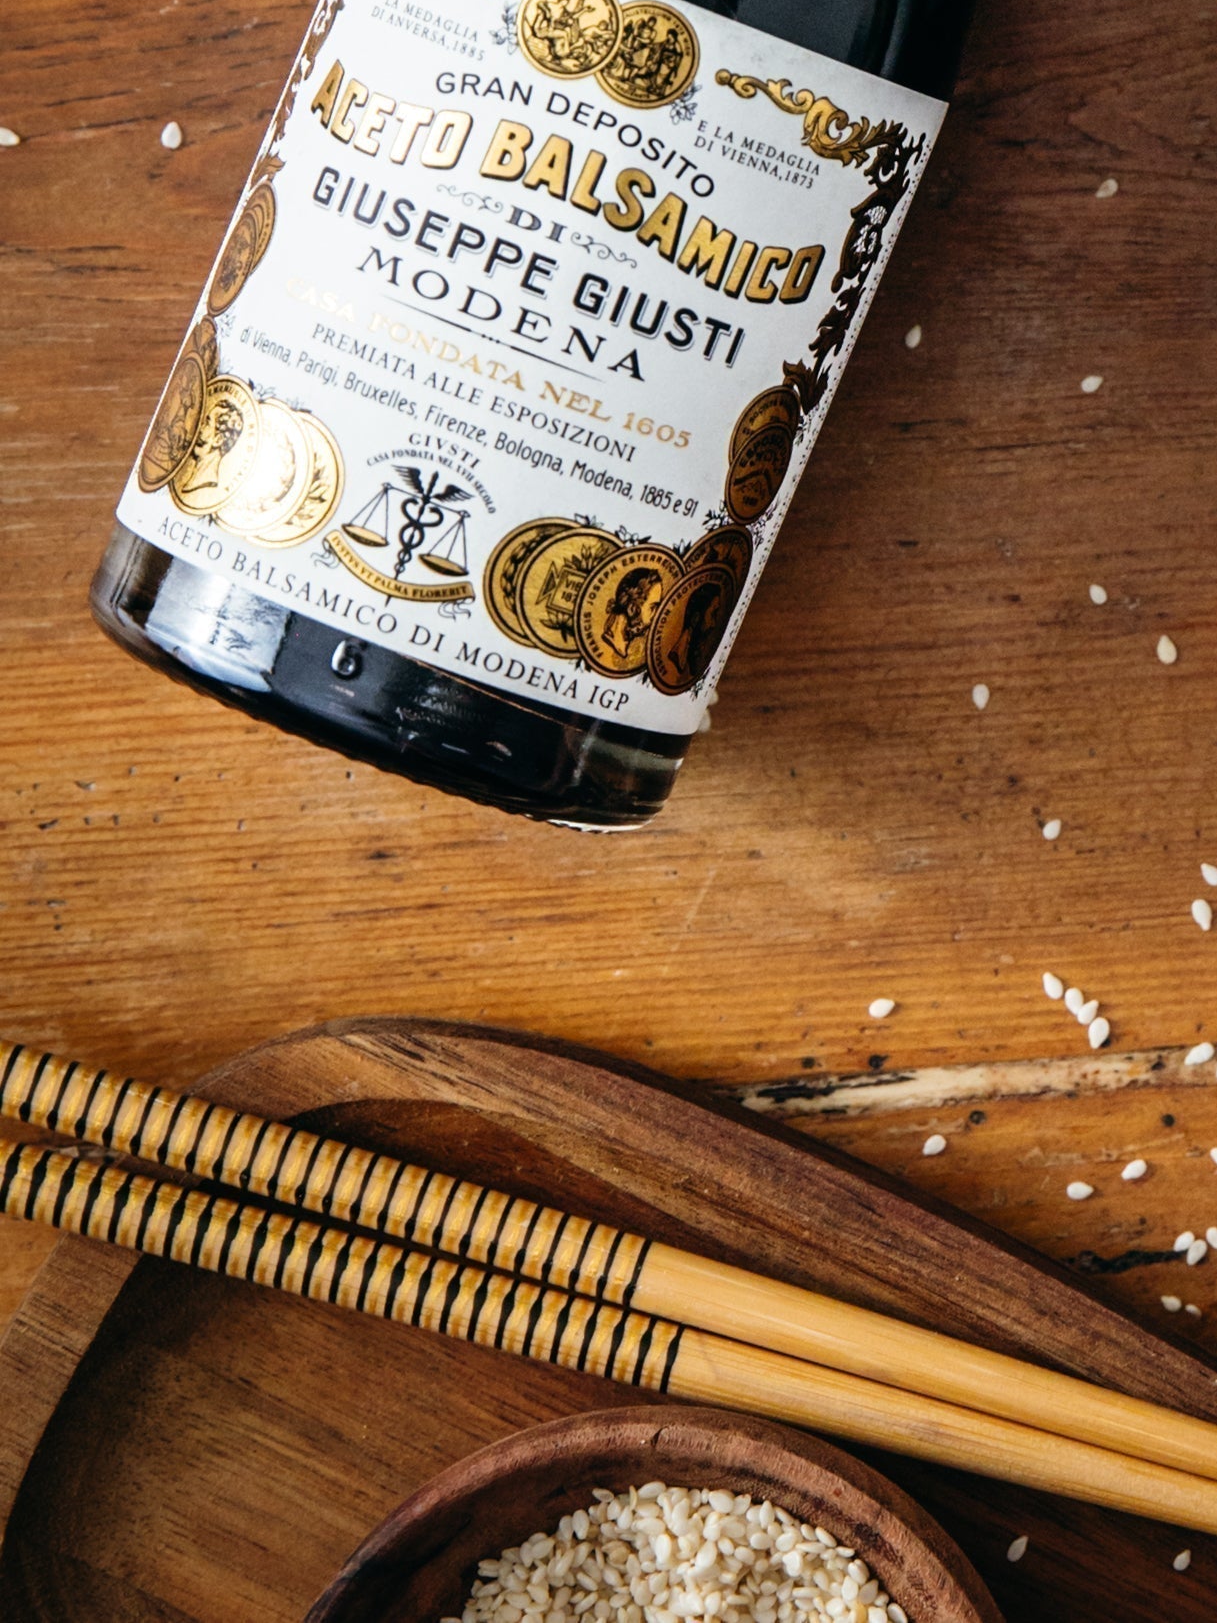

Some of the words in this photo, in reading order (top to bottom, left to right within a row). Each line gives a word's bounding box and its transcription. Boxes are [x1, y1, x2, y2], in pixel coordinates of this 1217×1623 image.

[371, 6, 384, 19] DI
[402, 3, 480, 43] MEDAGLIA
[310, 59, 474, 170] ACETO
[479, 118, 826, 305] BALSAMICO
[436, 71, 534, 106] GRAN
[546, 91, 715, 198] DEPOSITO
[694, 135, 714, 153] DI
[697, 120, 707, 133] E
[714, 125, 735, 144] LA
[739, 133, 821, 177] MEDAGLIA
[312, 166, 559, 298] GIUSEPPE
[572, 272, 747, 369] GIUSTI
[506, 204, 569, 244] DI
[355, 246, 646, 382] MODENA
[285, 278, 356, 323] CASA
[368, 312, 526, 392] FONDATA
[539, 380, 612, 422] NEL
[623, 412, 693, 449] 1605
[311, 323, 416, 380] PREMIATA
[423, 372, 484, 405] ALLE
[490, 395, 637, 463] ESPOSIZIONI
[239, 327, 252, 343] di
[253, 329, 292, 366] Vienna,
[296, 350, 338, 387] Parigi,
[344, 371, 418, 420] Bruxelles,
[424, 401, 488, 447] Firenze,
[494, 431, 564, 476] Bologna,
[569, 460, 634, 501] Modena,
[640, 484, 672, 511] 1885
[672, 500, 682, 514] e
[682, 498, 699, 519] 91
[408, 432, 481, 469] GIVSTI
[366, 453, 390, 467] CASA
[391, 448, 434, 461] FONDATA
[438, 454, 453, 470] NEL
[472, 479, 496, 515] SECOLO
[332, 535, 360, 571] IVSTVS
[360, 566, 372, 577] VT
[374, 576, 409, 596] PALMA
[157, 516, 224, 561] ACETO
[232, 551, 399, 634] BALSAMICO
[409, 623, 446, 653] DI
[455, 642, 578, 700] MODENA
[588, 684, 630, 713] IGP
